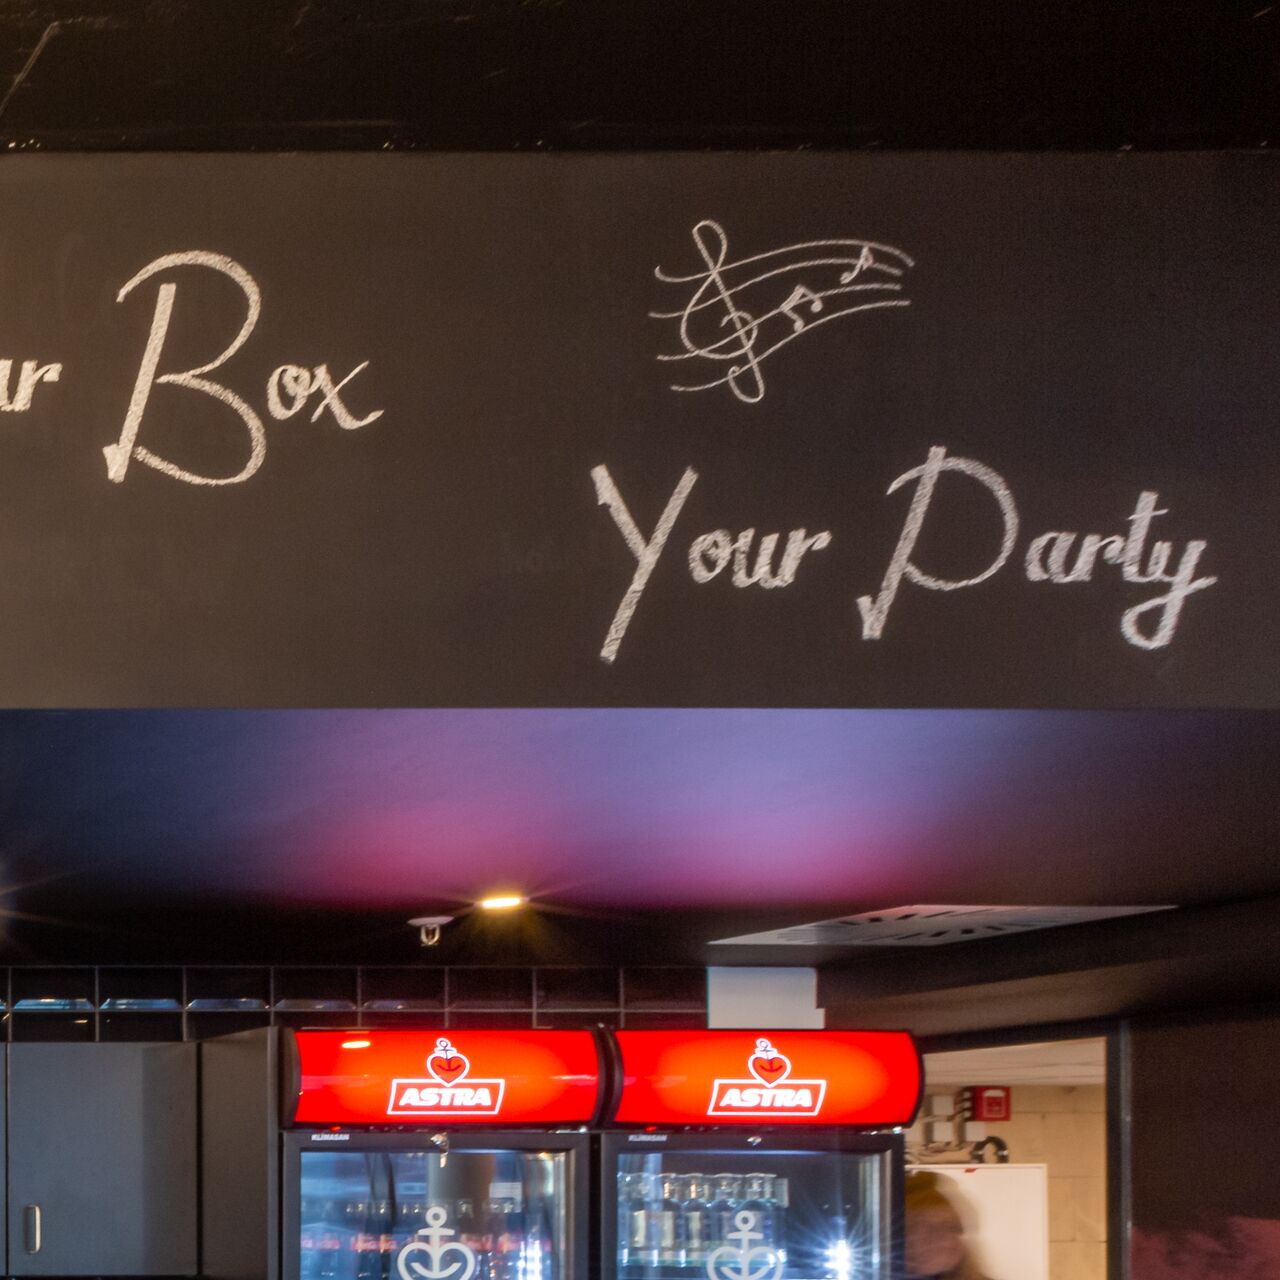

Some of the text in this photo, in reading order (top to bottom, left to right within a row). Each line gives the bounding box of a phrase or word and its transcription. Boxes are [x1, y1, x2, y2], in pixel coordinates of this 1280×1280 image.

[103, 250, 385, 486] Box
[590, 446, 1218, 664] Your Party
[399, 1088, 492, 1107] ASTRA
[720, 1088, 813, 1108] ASTRA
